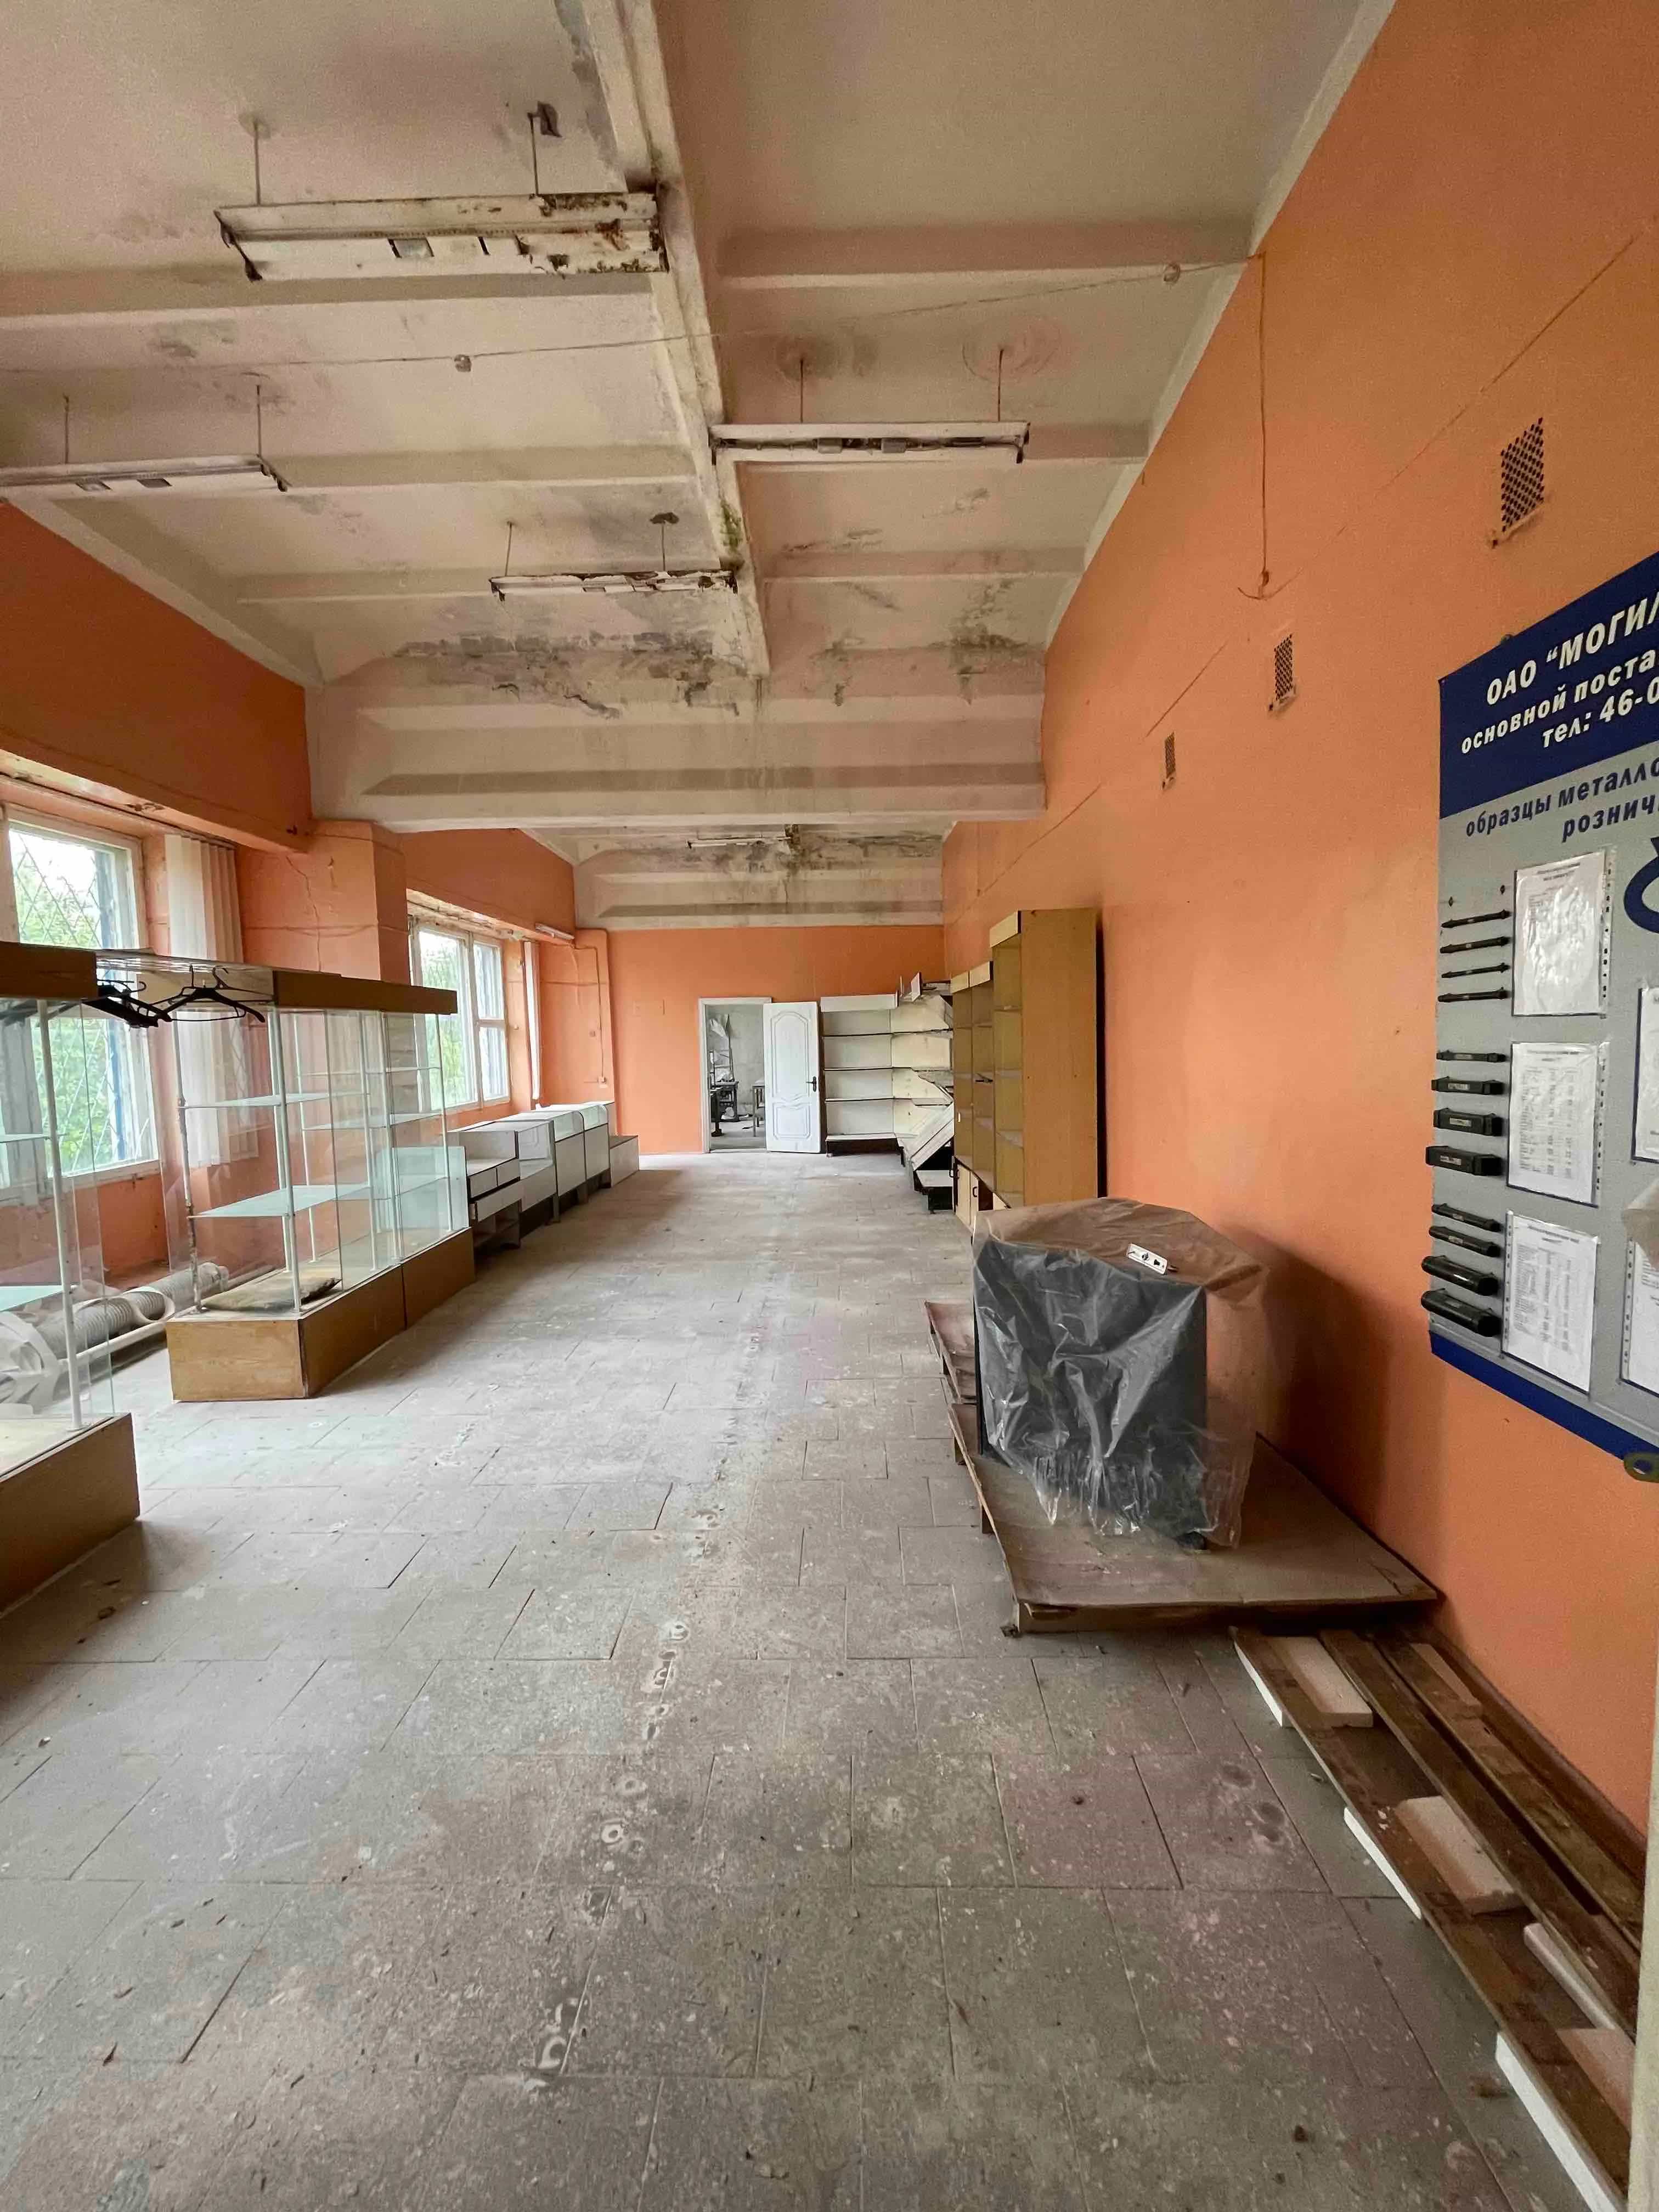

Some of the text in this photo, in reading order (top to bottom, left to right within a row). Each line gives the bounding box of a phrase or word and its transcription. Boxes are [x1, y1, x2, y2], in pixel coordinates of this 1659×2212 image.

[1487, 660, 1536, 705] ОАО
[1462, 684, 1567, 754] основной
[1466, 794, 1552, 837] образцы
[1562, 794, 1659, 843] рознич
